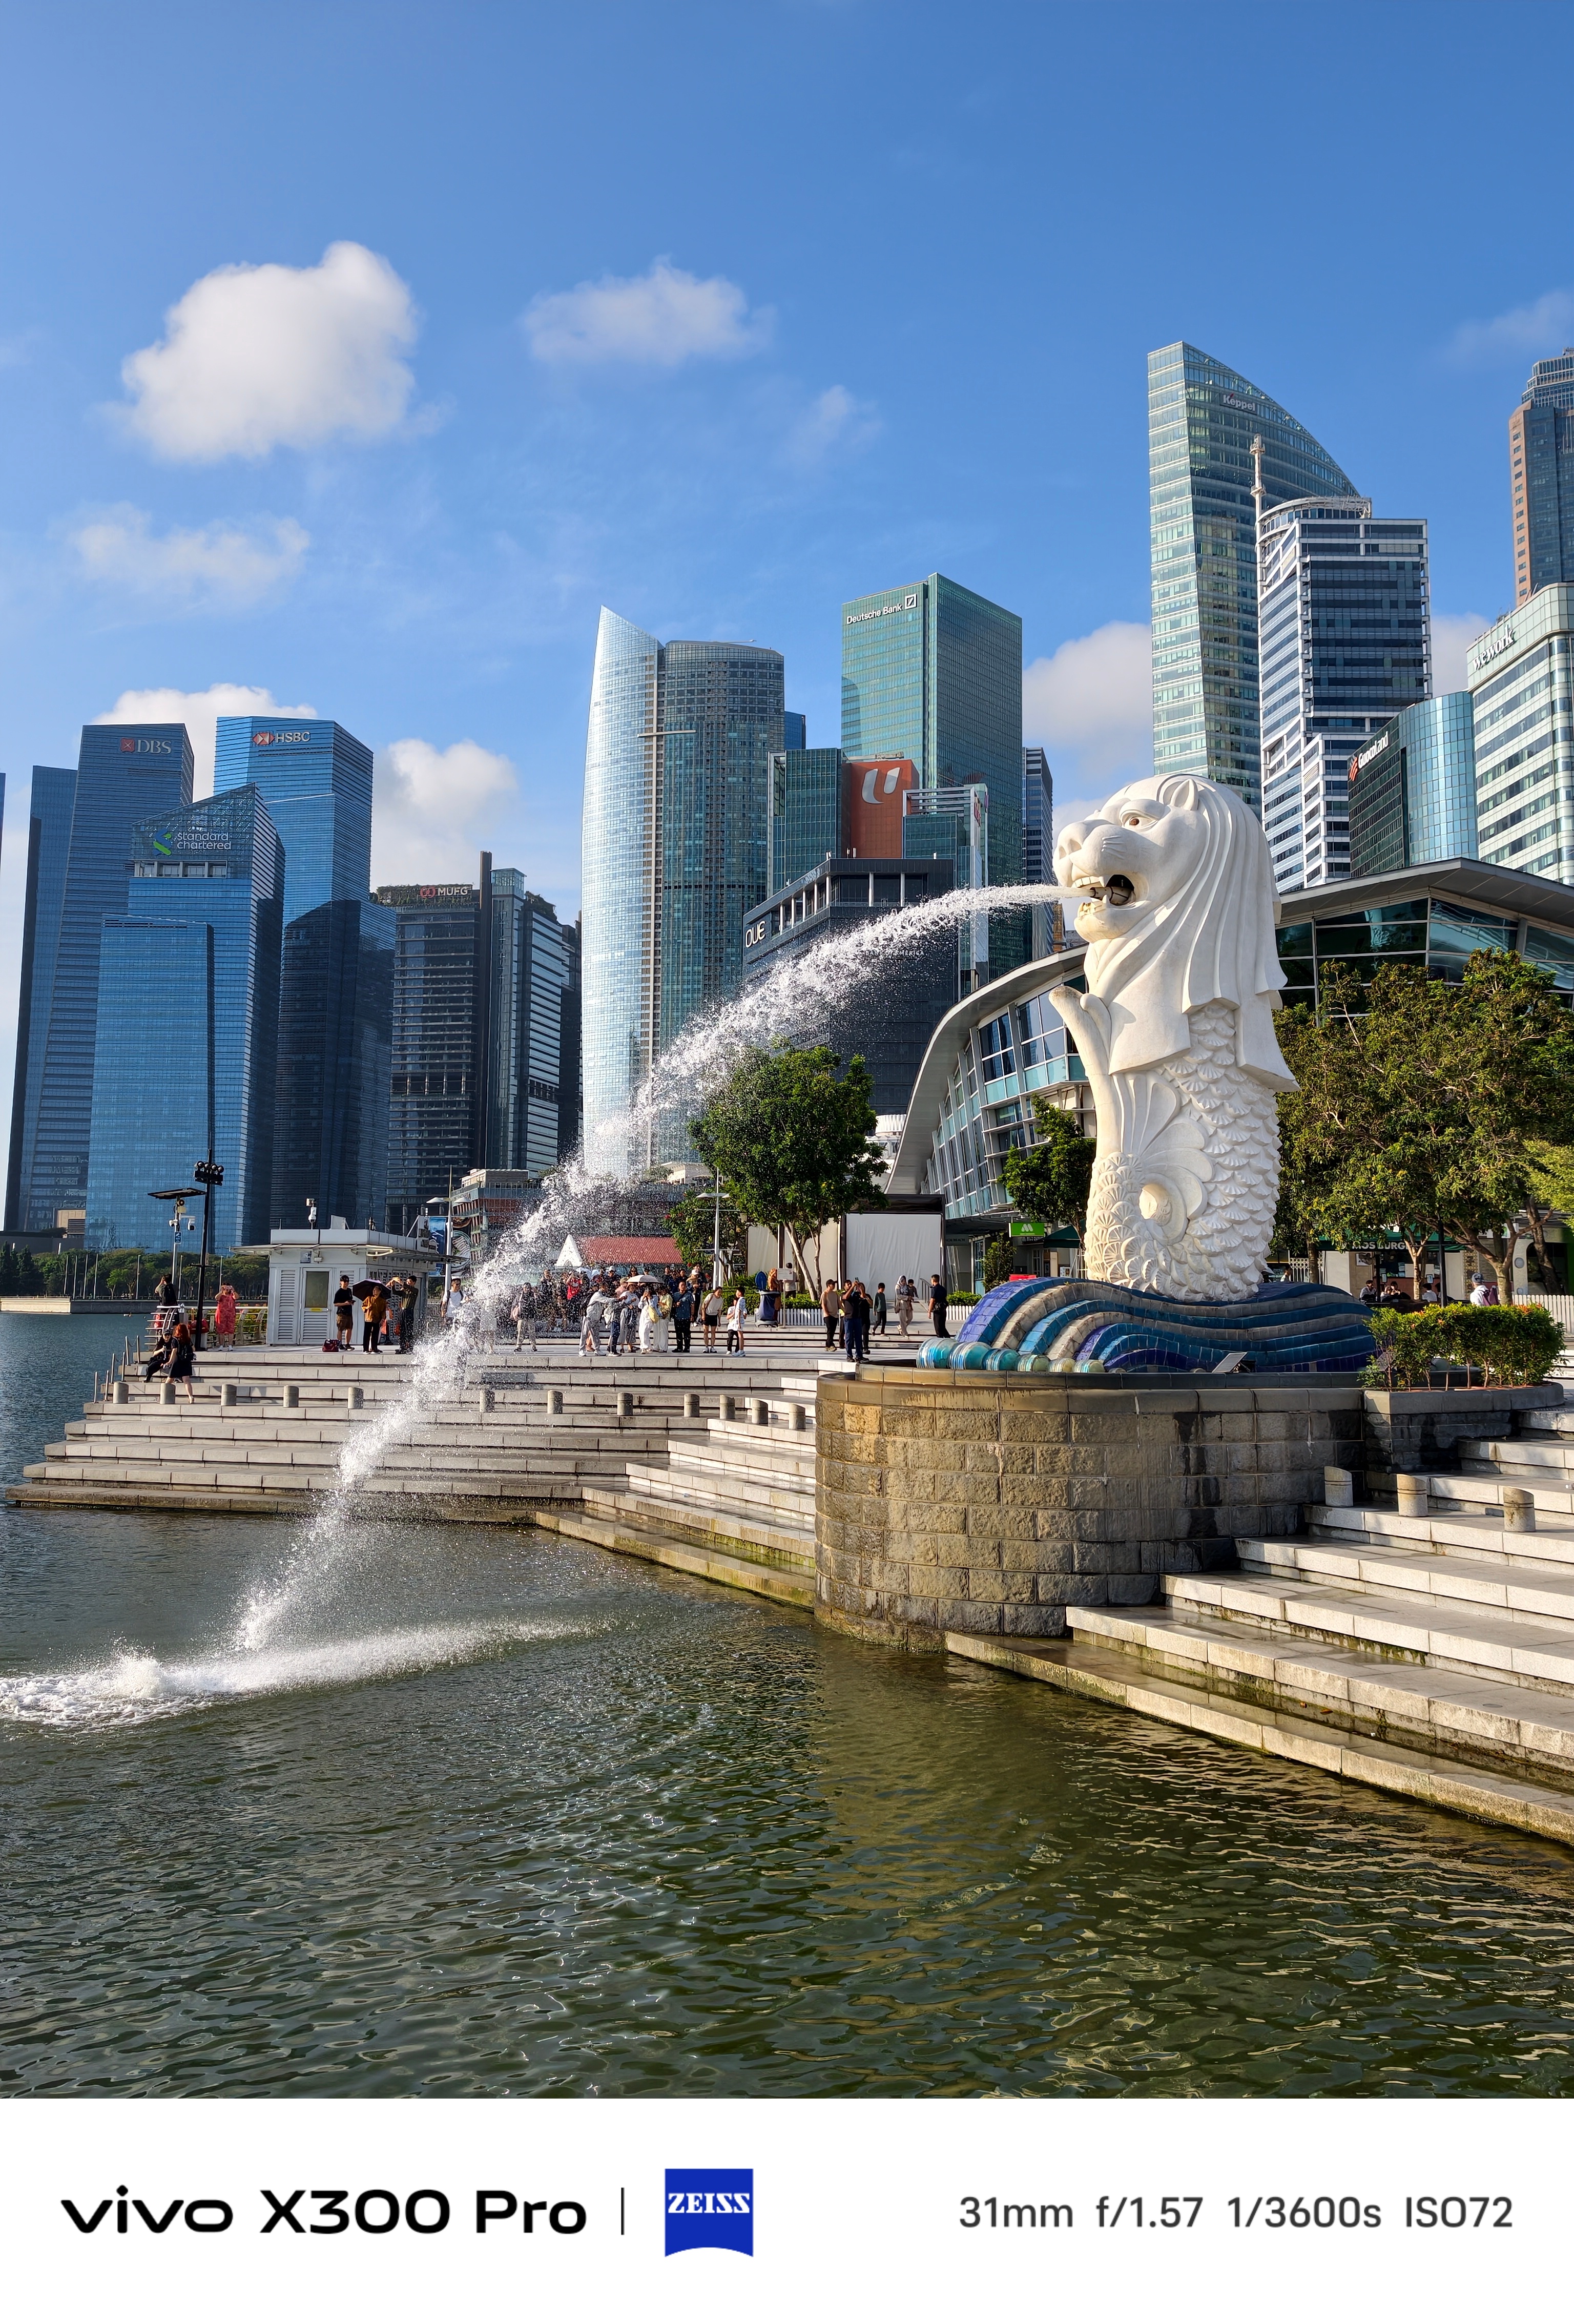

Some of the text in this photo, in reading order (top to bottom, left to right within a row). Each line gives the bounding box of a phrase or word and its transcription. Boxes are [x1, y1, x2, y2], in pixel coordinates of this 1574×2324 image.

[1223, 394, 1255, 411] Keppel
[846, 603, 902, 625] Deutsche Bank
[1473, 624, 1514, 670] wework
[276, 732, 310, 743] HSBC
[137, 739, 171, 754] DBS
[1358, 731, 1388, 769] GuocoLand
[177, 832, 229, 840] standard
[177, 841, 231, 849] chartered
[438, 887, 468, 896] MUFG
[745, 921, 765, 948] OUE
